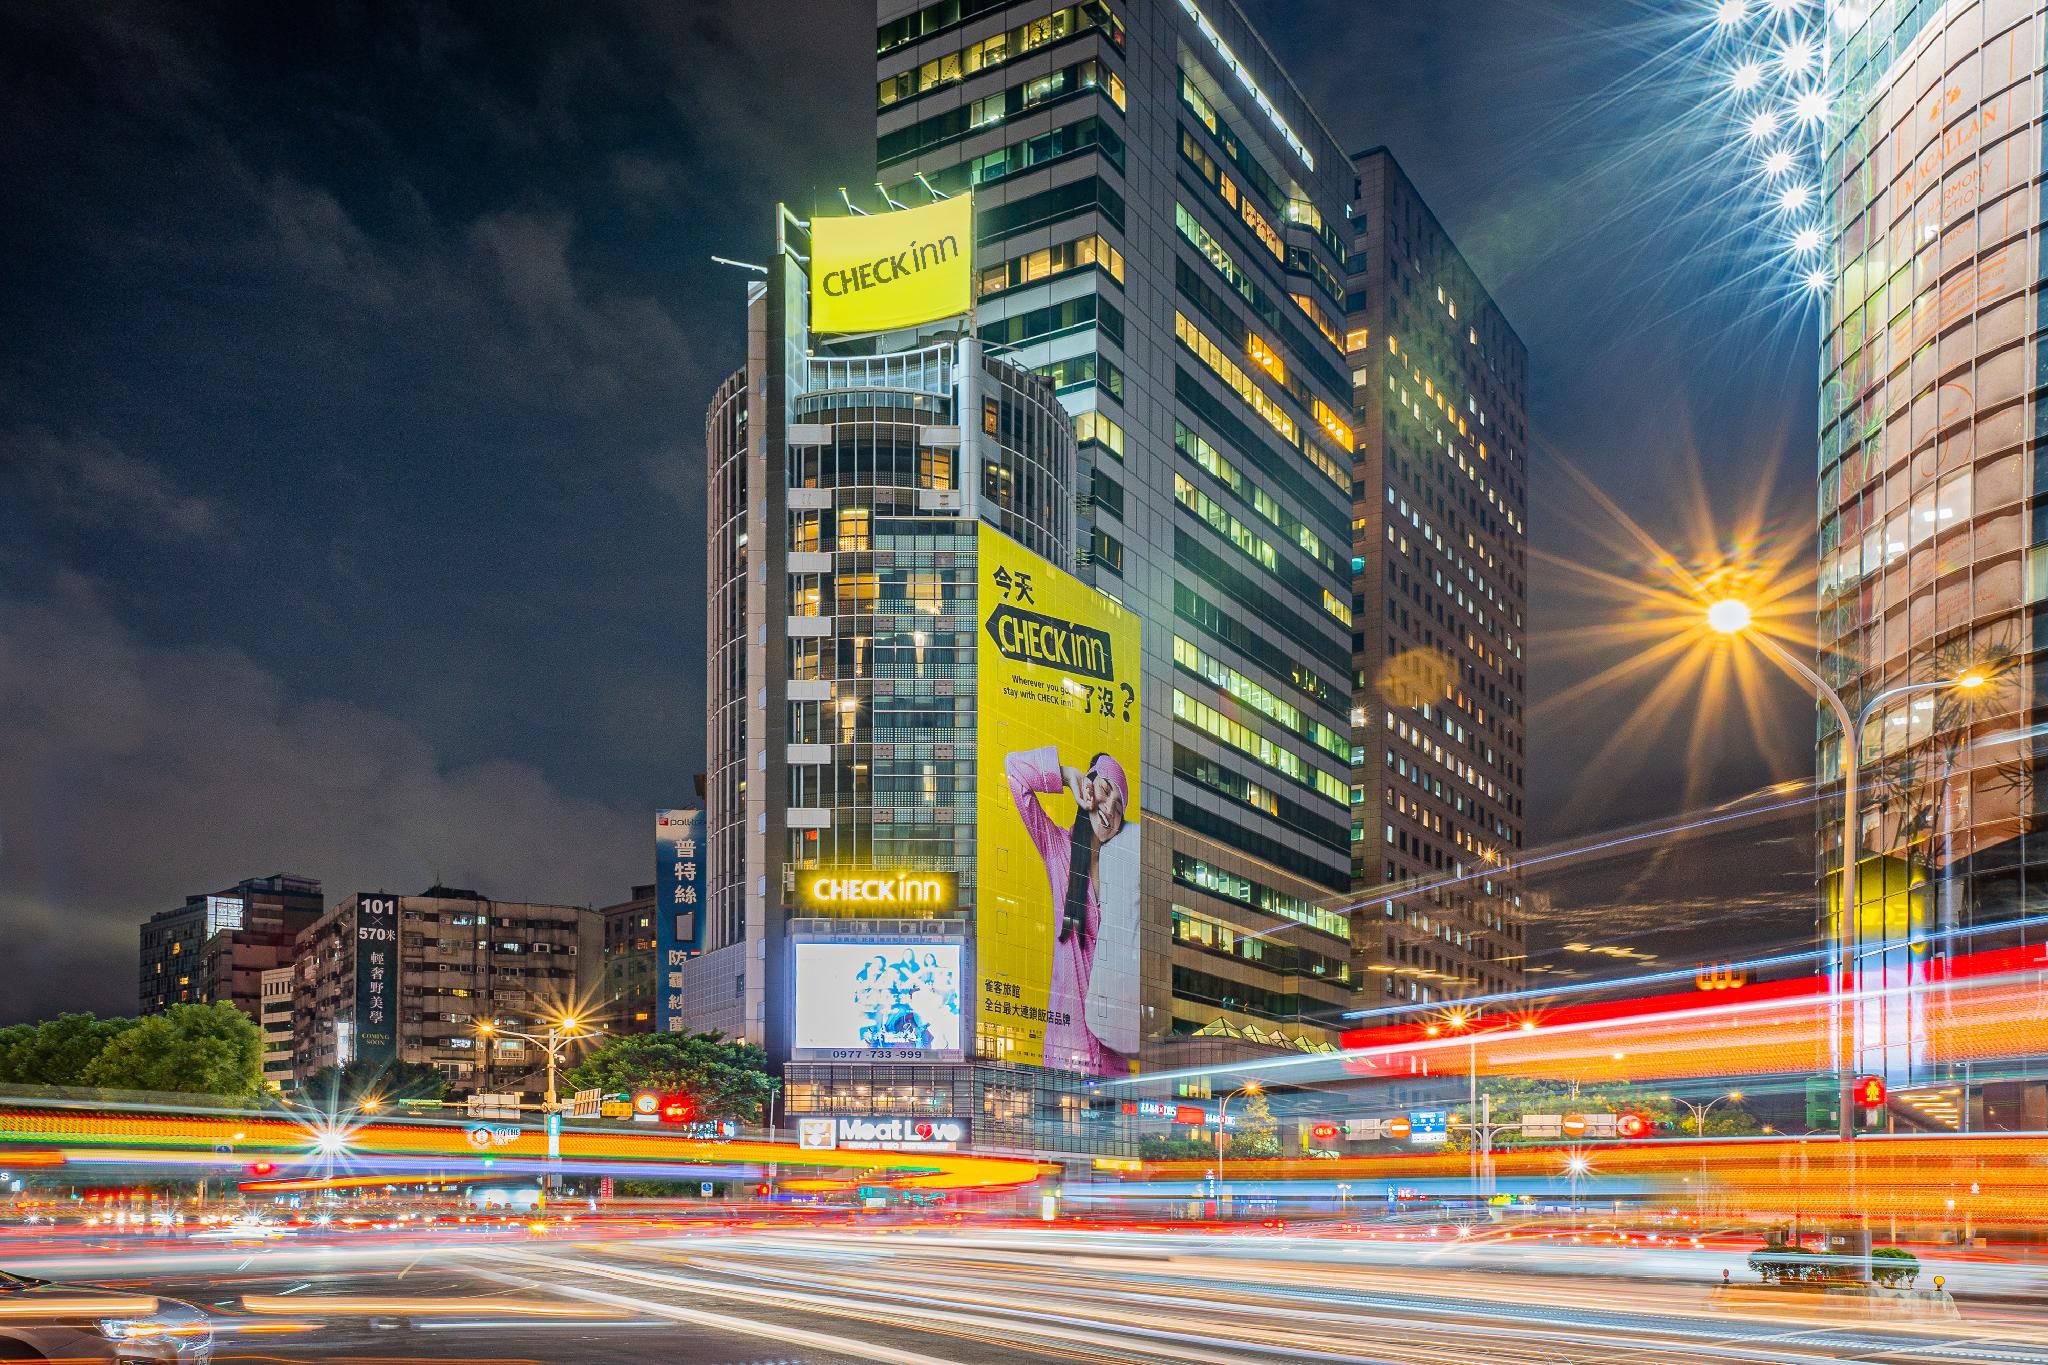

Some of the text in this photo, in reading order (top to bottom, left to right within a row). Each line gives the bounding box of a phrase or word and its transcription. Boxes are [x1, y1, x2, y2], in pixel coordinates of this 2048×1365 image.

[1904, 102, 1998, 200] MACALLAN
[992, 565, 1034, 605] 今天
[1012, 674, 1044, 689] Wherever
[1046, 683, 1059, 692] you
[1003, 687, 1018, 699] stay
[1020, 690, 1036, 700] with
[1037, 693, 1059, 706] CHECK
[674, 838, 697, 905] 普特絲
[361, 899, 394, 915] 101
[369, 952, 385, 1024] 輕奢野美學
[985, 979, 1020, 999] 雀客旅館
[985, 998, 1071, 1027] 全台最大連鎖飯店品牌
[366, 1038, 385, 1046] SOON
[840, 1119, 901, 1141] Meat
